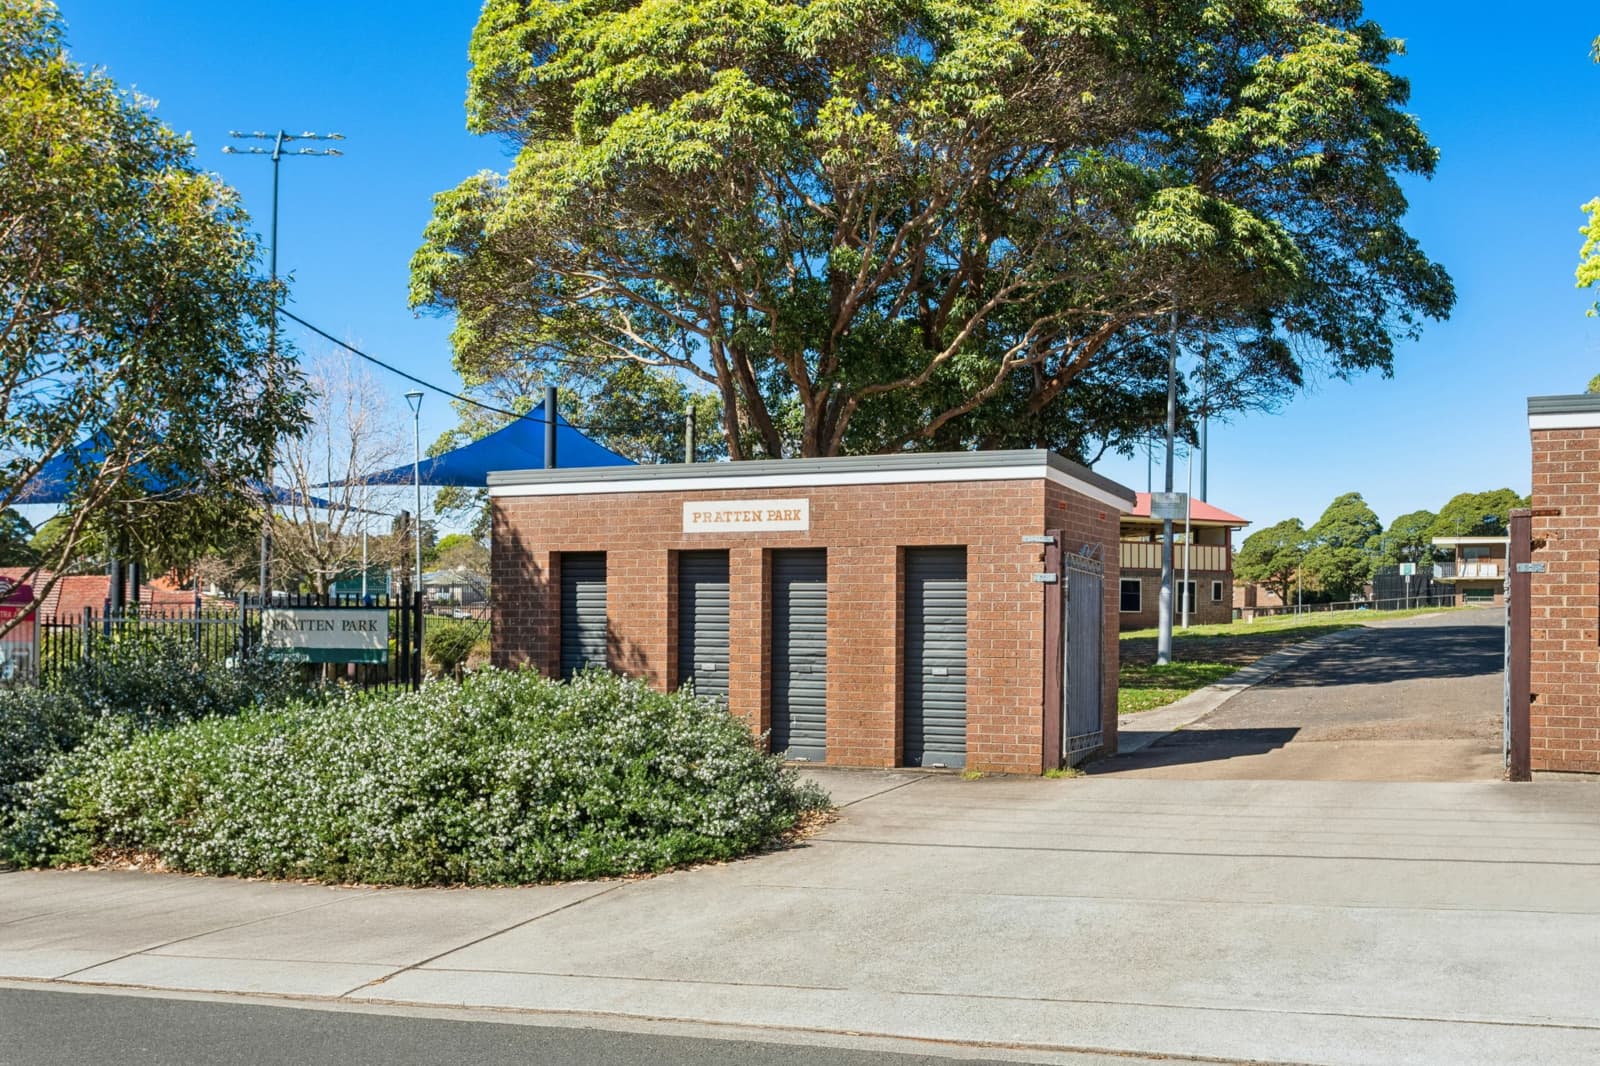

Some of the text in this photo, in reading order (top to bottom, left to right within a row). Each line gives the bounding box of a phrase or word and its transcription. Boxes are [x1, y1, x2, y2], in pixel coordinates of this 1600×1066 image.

[692, 509, 802, 524] PRATTEN PARK
[272, 619, 378, 632] PRATTEN PARK
